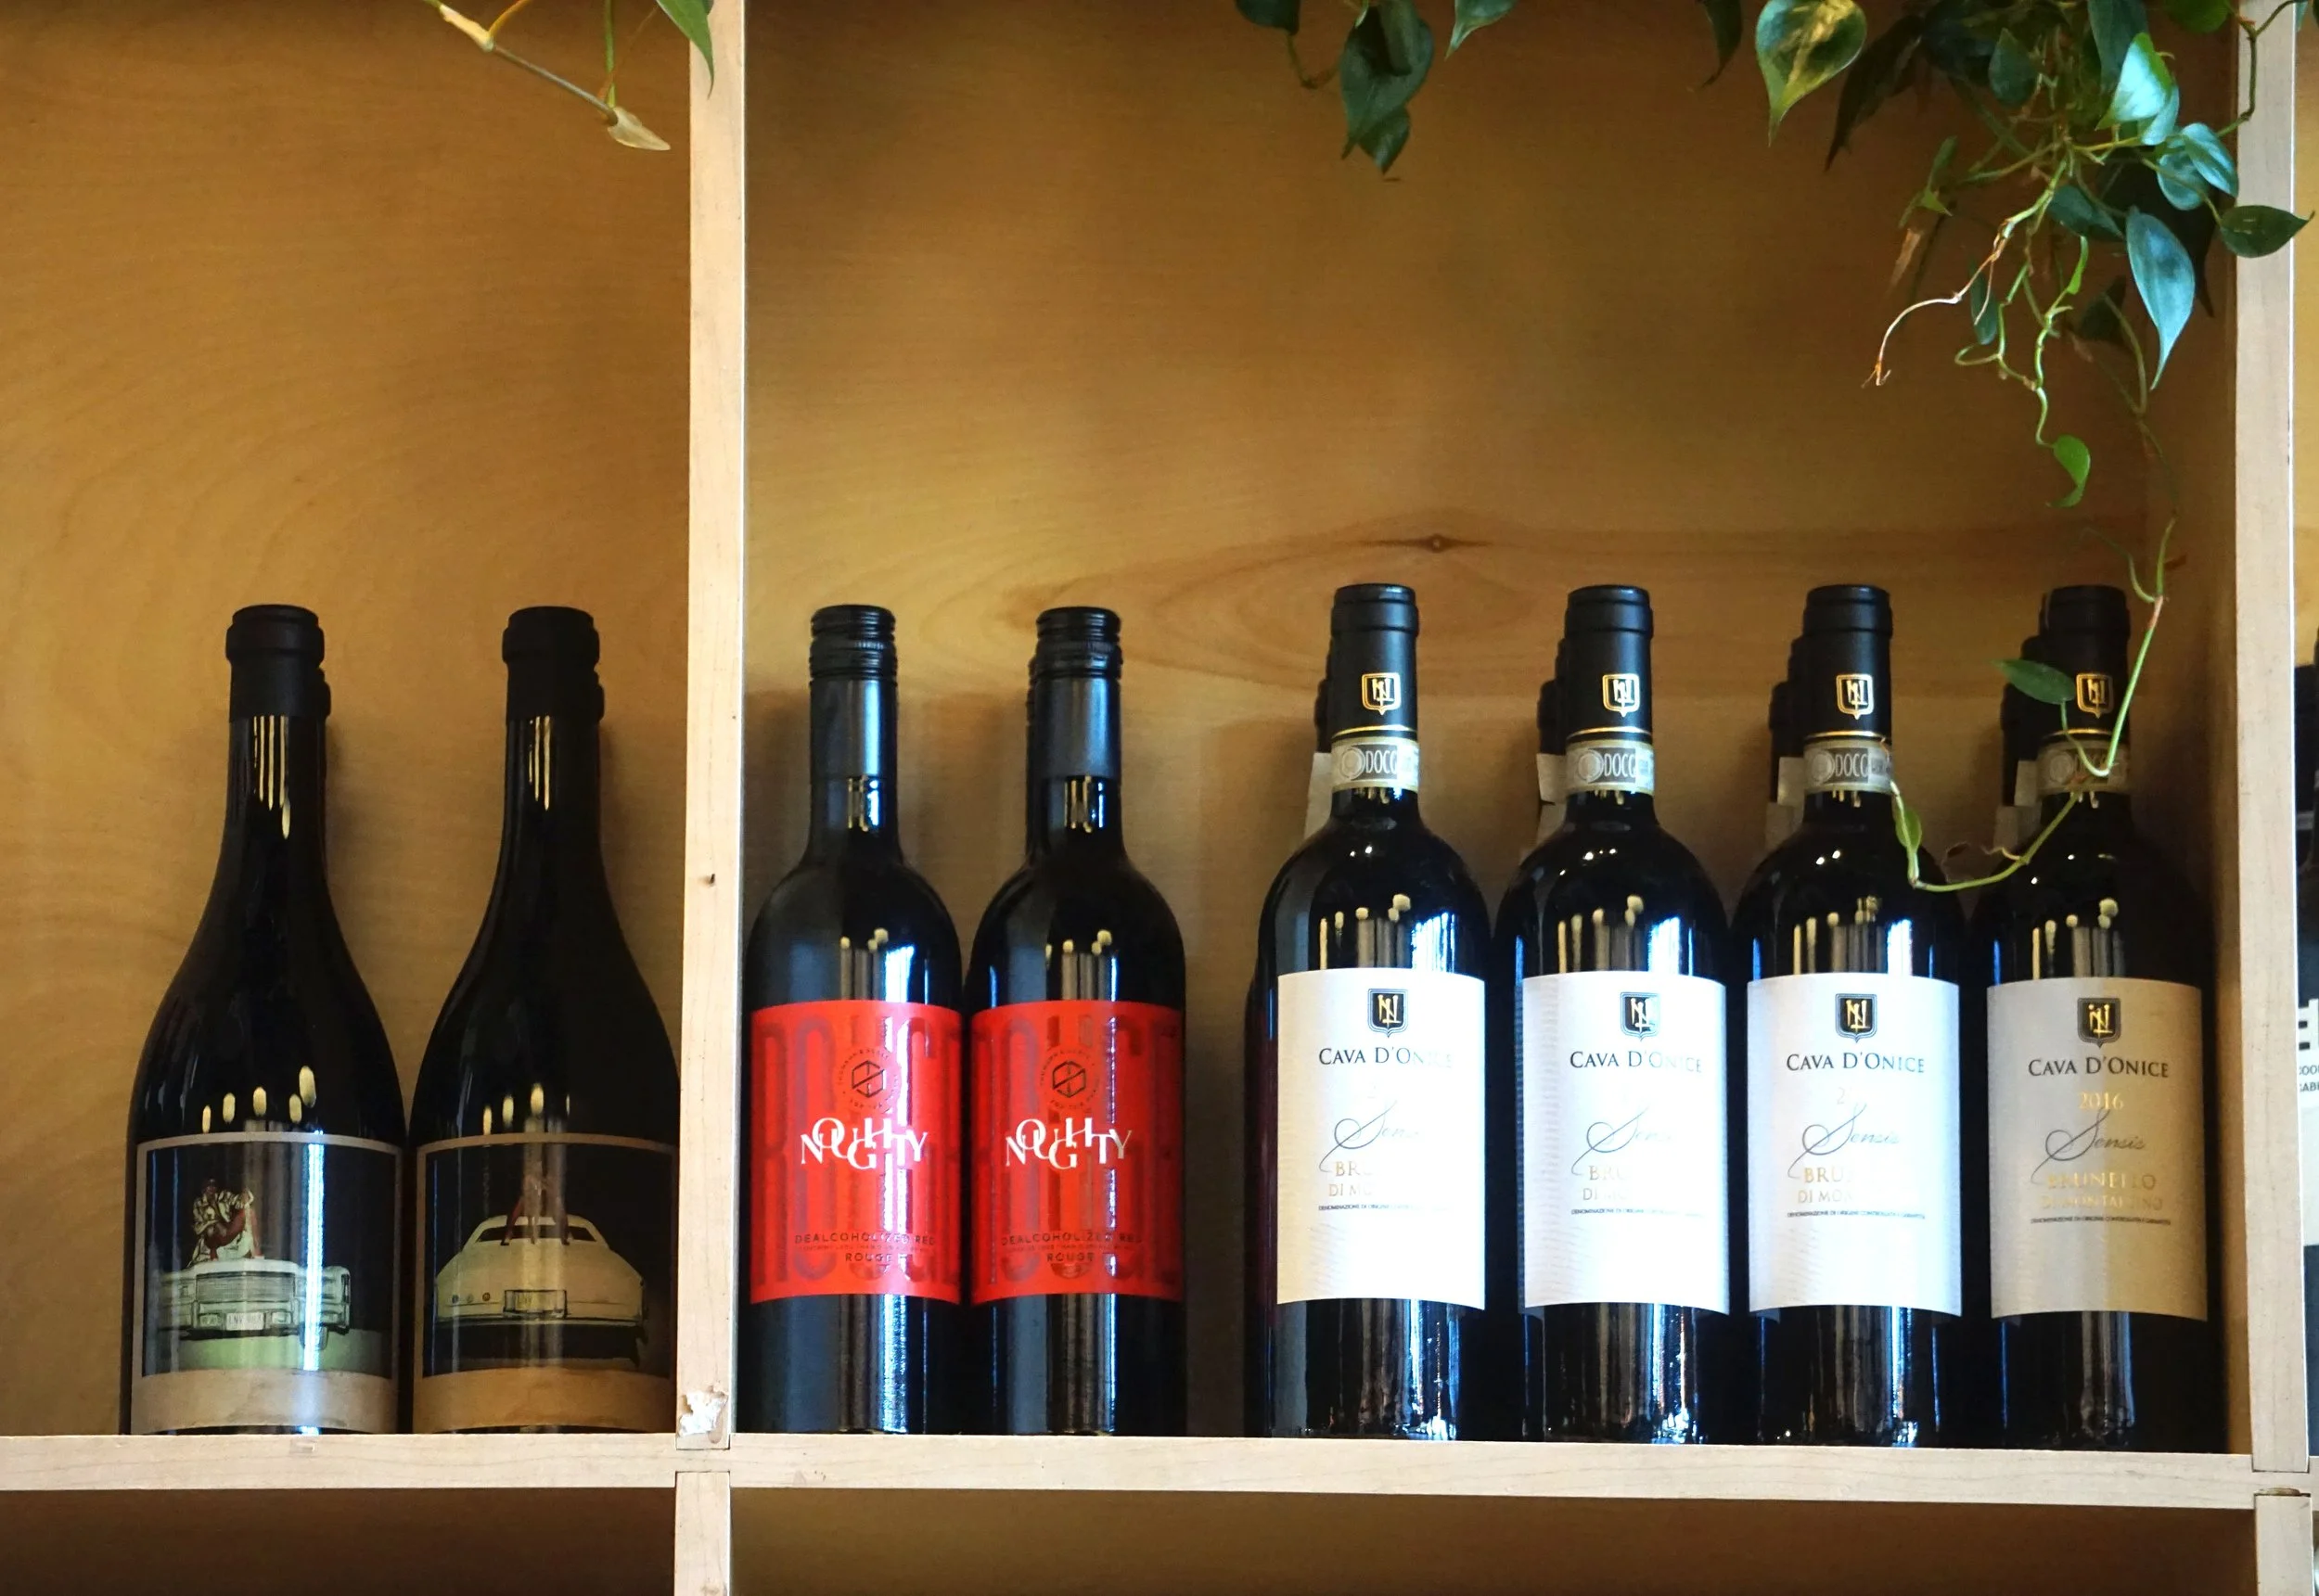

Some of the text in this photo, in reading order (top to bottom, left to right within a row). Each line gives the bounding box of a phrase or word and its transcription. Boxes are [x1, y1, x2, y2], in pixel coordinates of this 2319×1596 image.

[1318, 1047, 1366, 1066] CAVA
[1569, 1050, 1620, 1068] CAVA
[1786, 1052, 1925, 1073] CAVA D'ONICE
[2028, 1056, 2170, 1078] CAVA D'ONICE
[2078, 1092, 2124, 1110] 2016
[801, 1117, 929, 1170] NOUGHTY
[1006, 1117, 1134, 1171] NOUGHTY
[2047, 1171, 2157, 1191] BRUNELO
